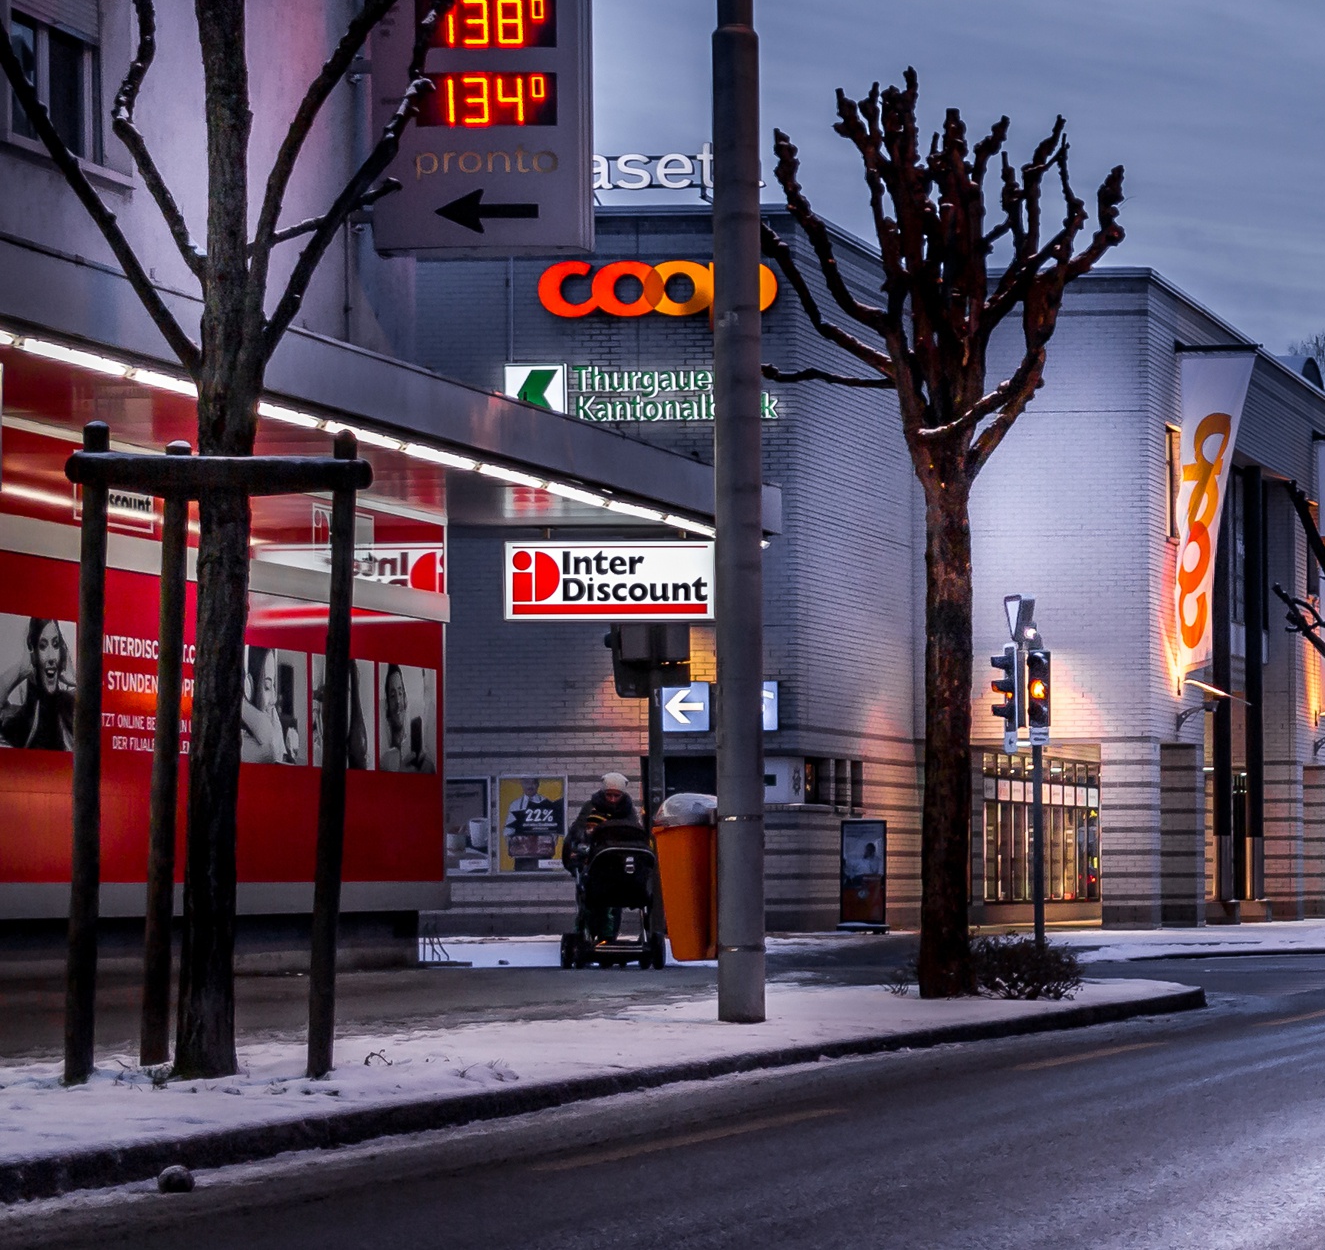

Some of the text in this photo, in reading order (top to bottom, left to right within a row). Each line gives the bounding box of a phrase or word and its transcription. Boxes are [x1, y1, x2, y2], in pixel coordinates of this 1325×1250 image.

[414, 144, 559, 181] pronto
[571, 365, 715, 398] Thurgaue
[574, 391, 779, 421] Kantonalk
[562, 550, 645, 576] Inter
[562, 576, 708, 602] Discount
[107, 670, 159, 694] STUNDEN
[117, 713, 145, 730] ONLINE
[112, 735, 127, 750] DER
[525, 809, 554, 822] 22%
